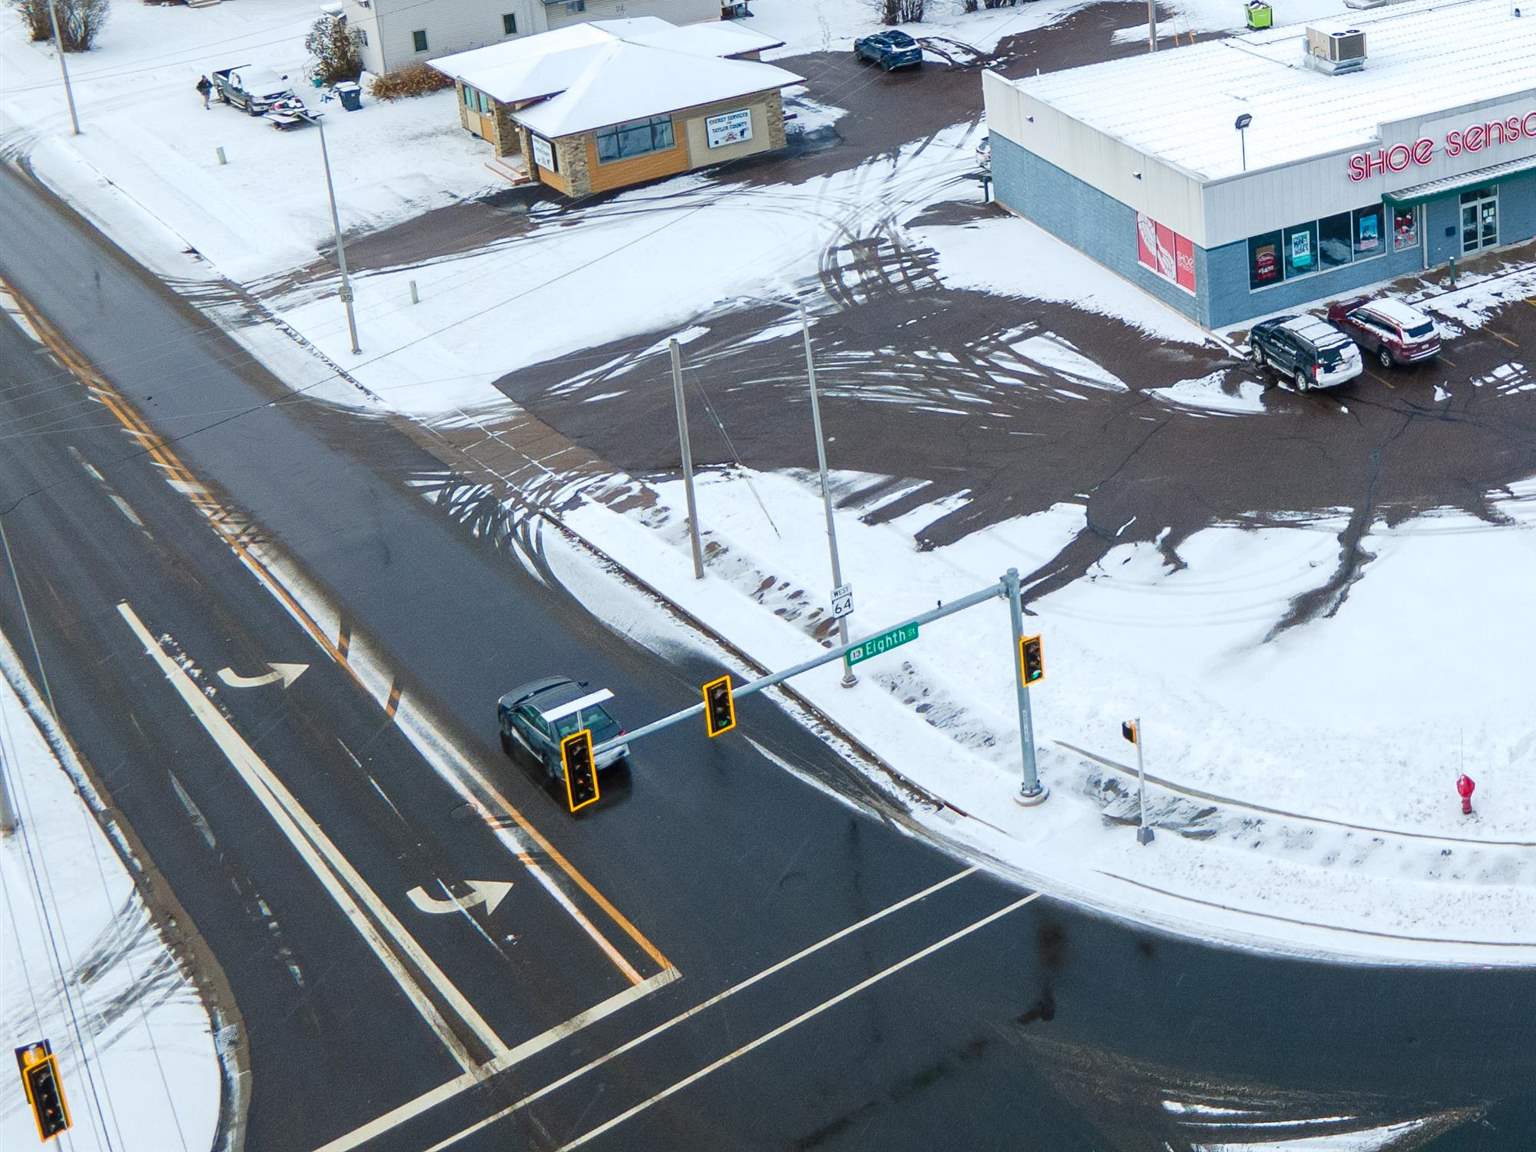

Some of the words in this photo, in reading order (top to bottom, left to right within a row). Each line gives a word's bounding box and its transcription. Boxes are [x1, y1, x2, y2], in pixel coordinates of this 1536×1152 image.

[833, 586, 849, 598] WEST
[834, 598, 851, 614] 64
[866, 628, 906, 656] Eighth
[908, 627, 916, 636] St
